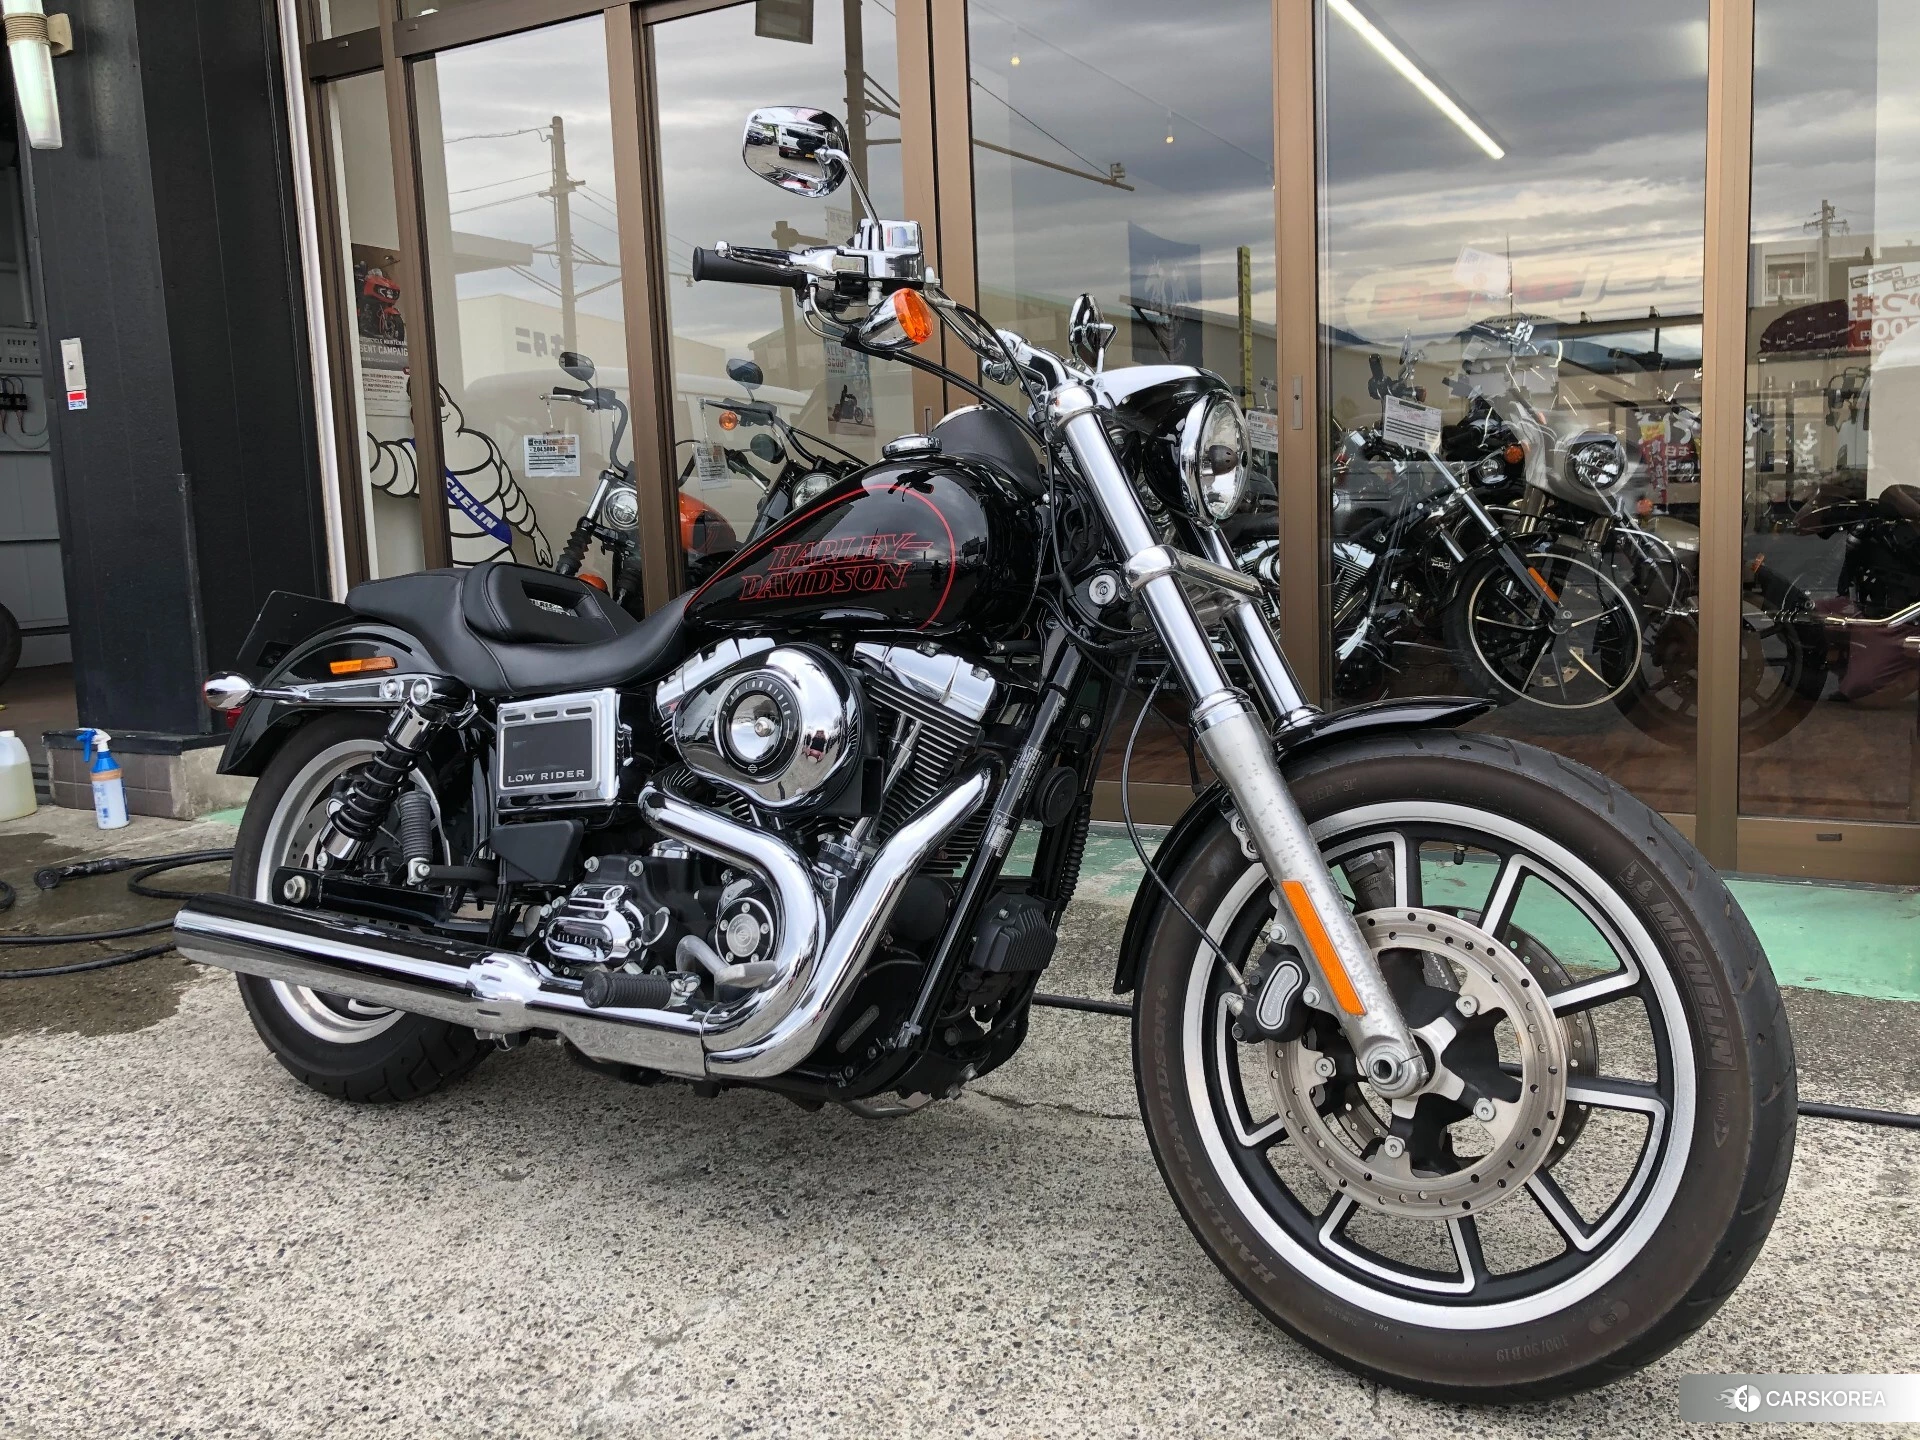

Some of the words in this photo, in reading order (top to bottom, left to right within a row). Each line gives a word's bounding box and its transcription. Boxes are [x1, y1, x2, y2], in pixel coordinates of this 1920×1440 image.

[739, 562, 912, 601] DAVIDSON
[507, 773, 536, 783] LOW
[540, 769, 585, 781] RIDER
[1650, 901, 1736, 1067] MICHELIN
